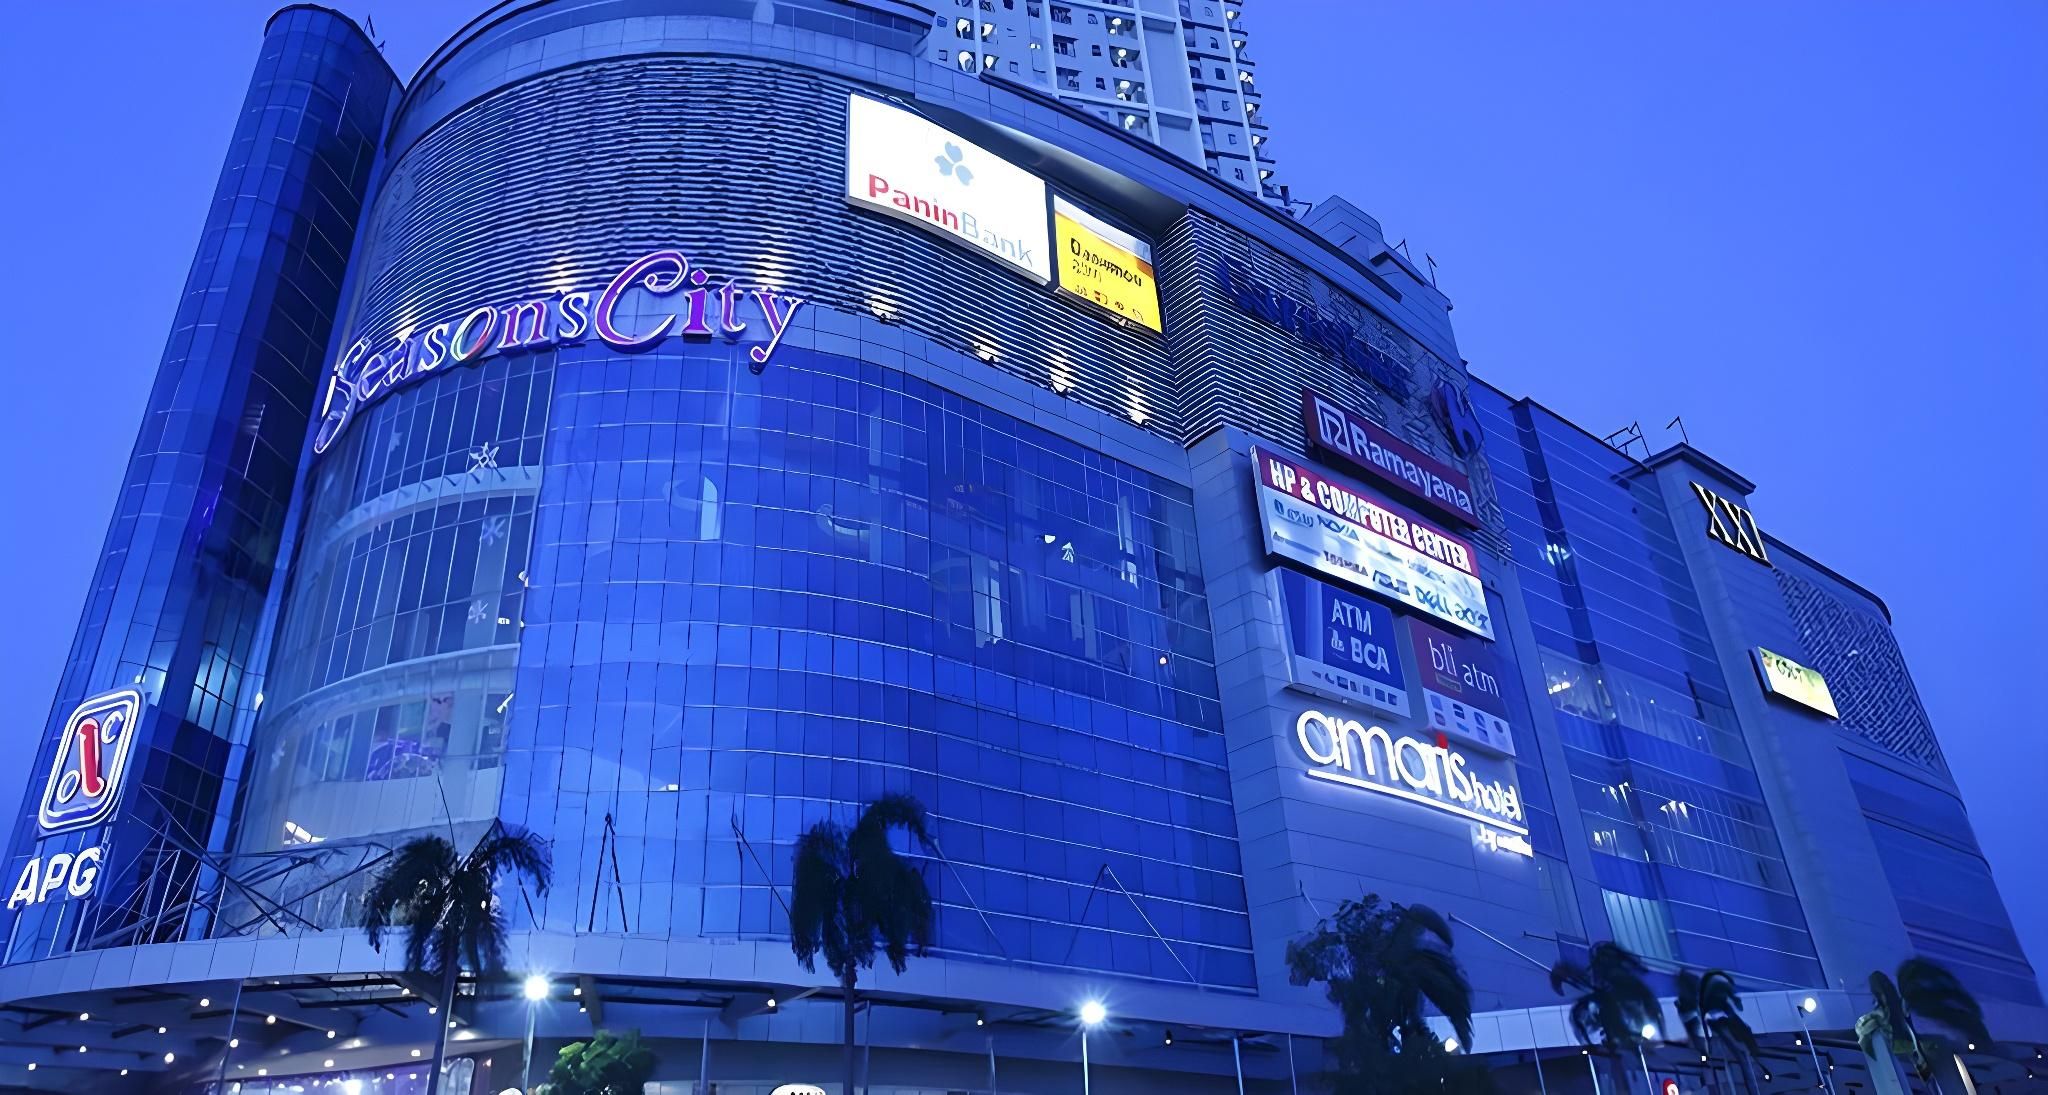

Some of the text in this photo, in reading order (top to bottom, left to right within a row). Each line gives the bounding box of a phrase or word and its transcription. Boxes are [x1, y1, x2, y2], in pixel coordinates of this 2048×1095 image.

[868, 174, 1033, 267] PaninBank
[1269, 458, 1297, 493] HP
[1350, 423, 1474, 515] Ramayana
[1690, 481, 1769, 564] XXI
[1331, 598, 1372, 637] ATM
[1350, 635, 1392, 676] BCA
[1462, 663, 1500, 699] atm
[1296, 710, 1473, 803] amaris
[7, 846, 101, 910] APG
